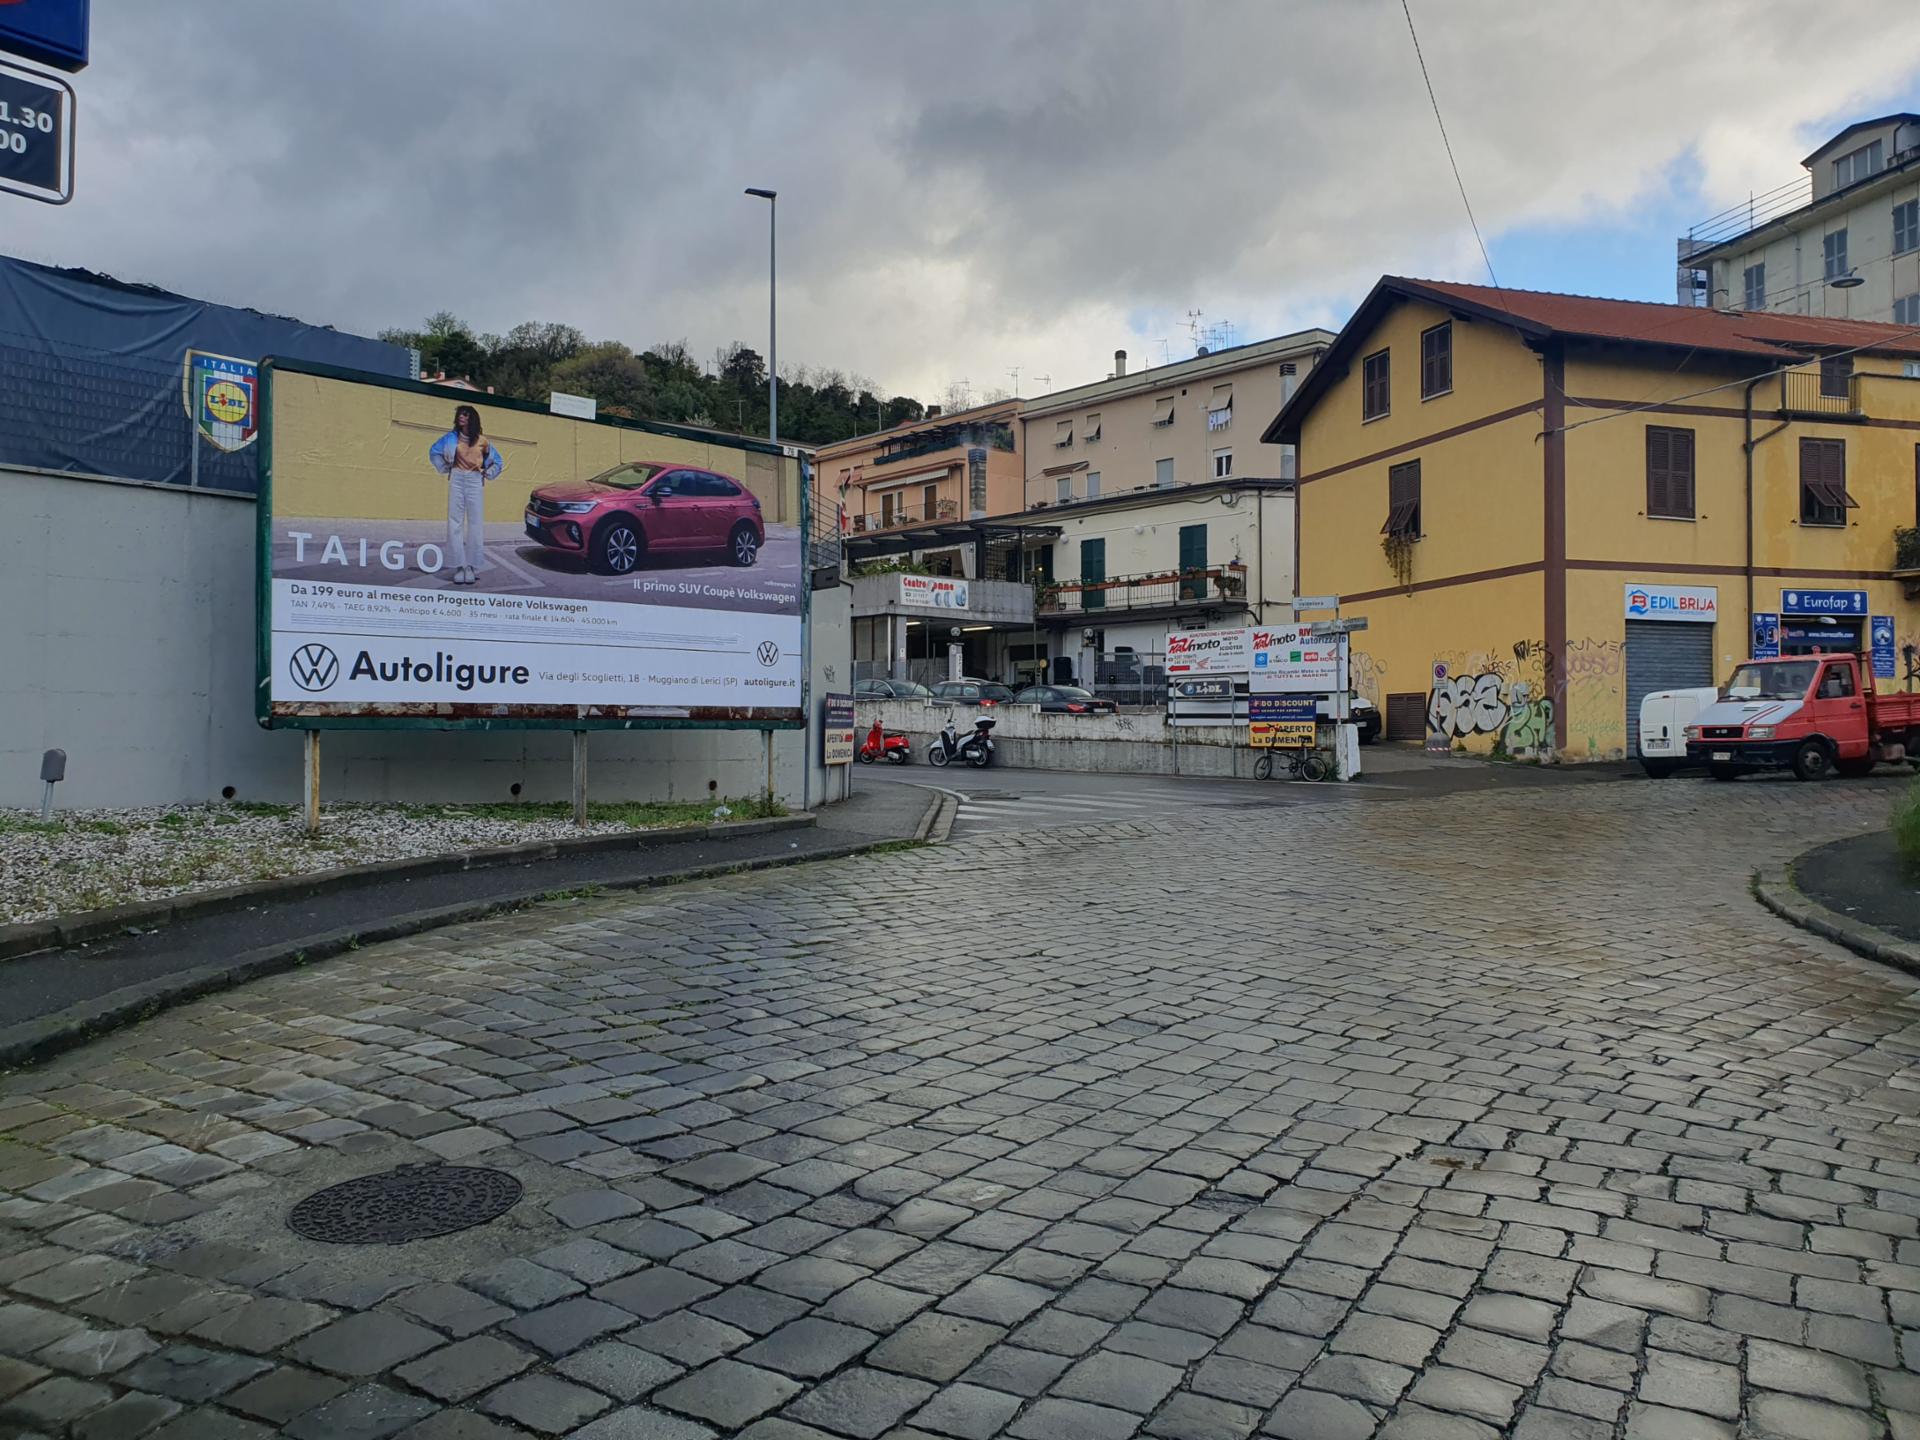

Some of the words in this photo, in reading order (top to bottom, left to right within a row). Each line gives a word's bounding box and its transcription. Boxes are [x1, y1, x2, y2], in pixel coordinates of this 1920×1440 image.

[203, 359, 254, 376] ITALIA
[288, 531, 444, 573] TAIGO
[291, 584, 307, 595] Da
[311, 585, 334, 596] 199
[337, 588, 364, 599] euro
[367, 590, 377, 600] al
[380, 592, 412, 602] mese
[414, 594, 434, 603] con
[437, 594, 486, 607] Progetto
[488, 598, 523, 608] Valore
[526, 600, 588, 613] Volkswagen
[633, 579, 641, 590] Il
[643, 580, 676, 593] primo
[678, 582, 702, 595] SUV
[737, 588, 796, 604] Volkswagen
[1650, 596, 1715, 611] EDILBRIJA
[1803, 595, 1848, 611] Eurofap
[291, 600, 308, 608] TAN
[343, 603, 365, 612] TAEG
[398, 607, 430, 616] Anticipo
[480, 611, 498, 619] mesi
[521, 613, 541, 621] finale
[607, 617, 618, 626] km
[1300, 636, 1346, 645] Autorizzto
[349, 650, 529, 691] Autoligure
[538, 671, 554, 681] Via
[556, 672, 579, 683] degli
[628, 674, 640, 683] 18
[648, 675, 689, 685] Muggiano
[691, 676, 699, 685] di
[700, 676, 721, 685] Lerici
[723, 677, 738, 687] (SP)
[744, 677, 796, 688] autoligure.it
